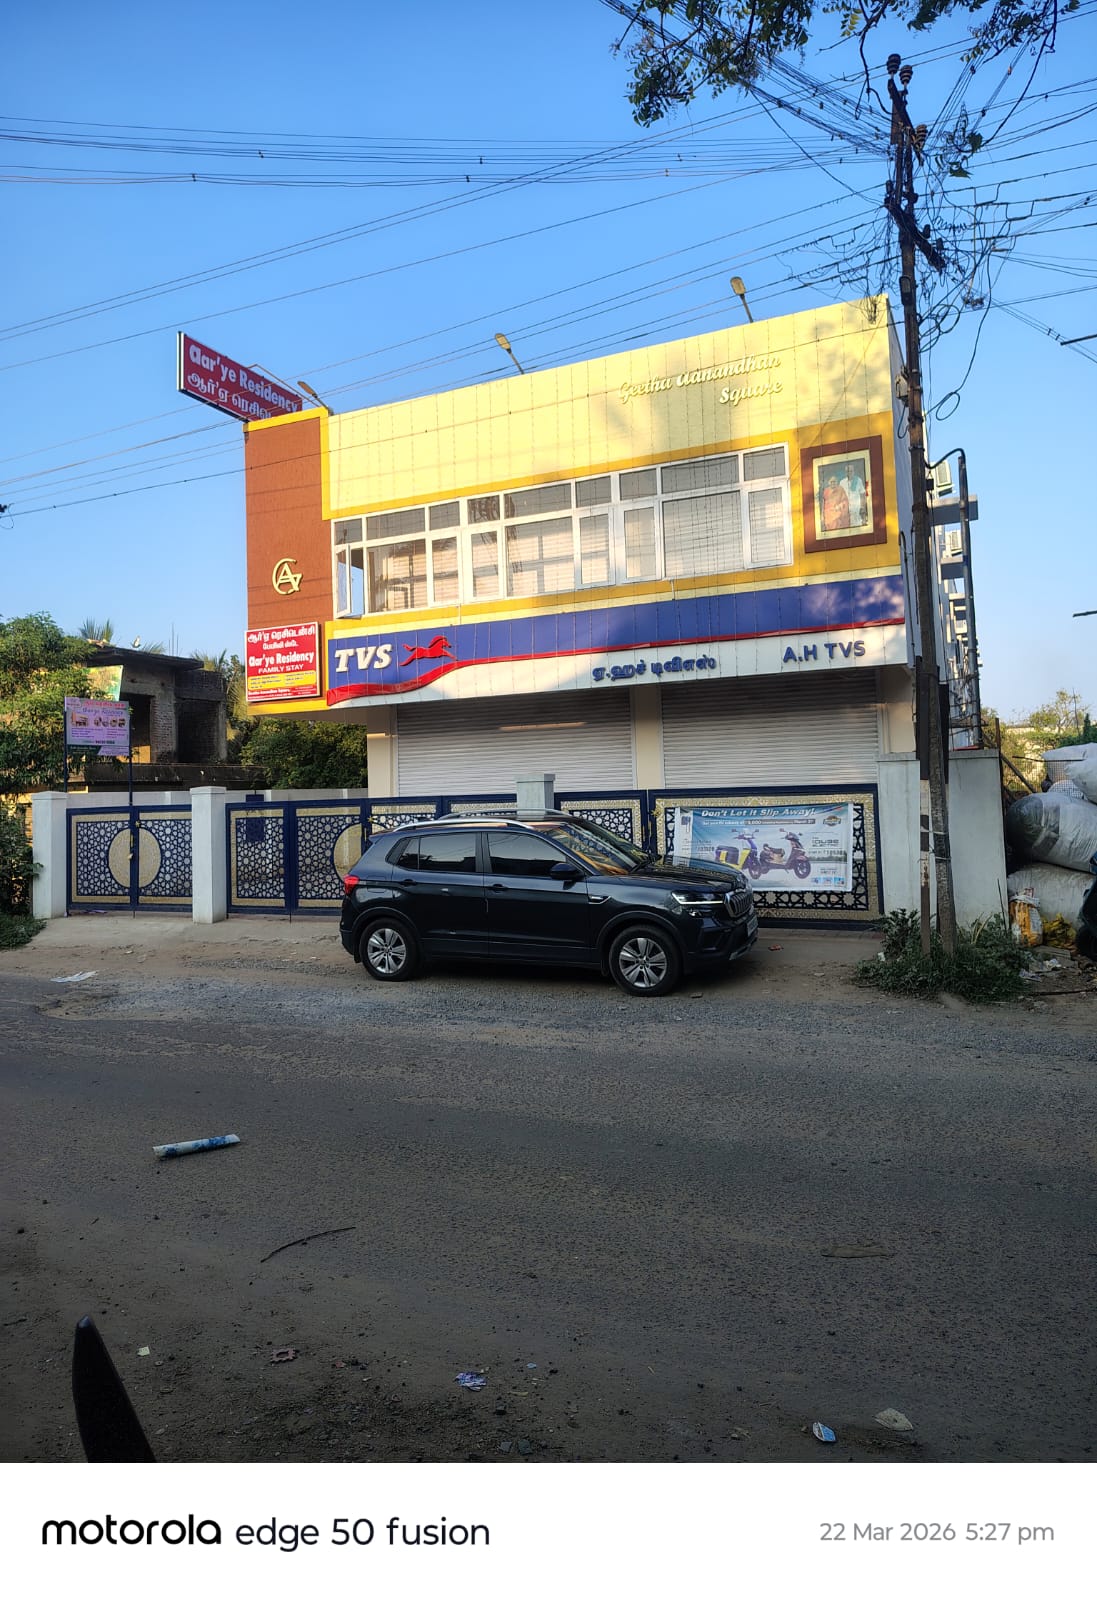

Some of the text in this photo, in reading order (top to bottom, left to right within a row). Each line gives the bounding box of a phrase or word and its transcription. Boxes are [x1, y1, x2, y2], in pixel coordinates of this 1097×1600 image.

[239, 369, 298, 413] Residency
[617, 376, 672, 405] Geetha
[719, 379, 783, 407] Square
[276, 651, 314, 664] Residency
[333, 643, 393, 673] TVS
[782, 640, 866, 664] A.H TVS
[258, 663, 304, 674] FAMILY STAY
[651, 654, 717, 678] டிவிஎஸ்
[730, 809, 747, 817] Let
[760, 809, 779, 817] Slip
